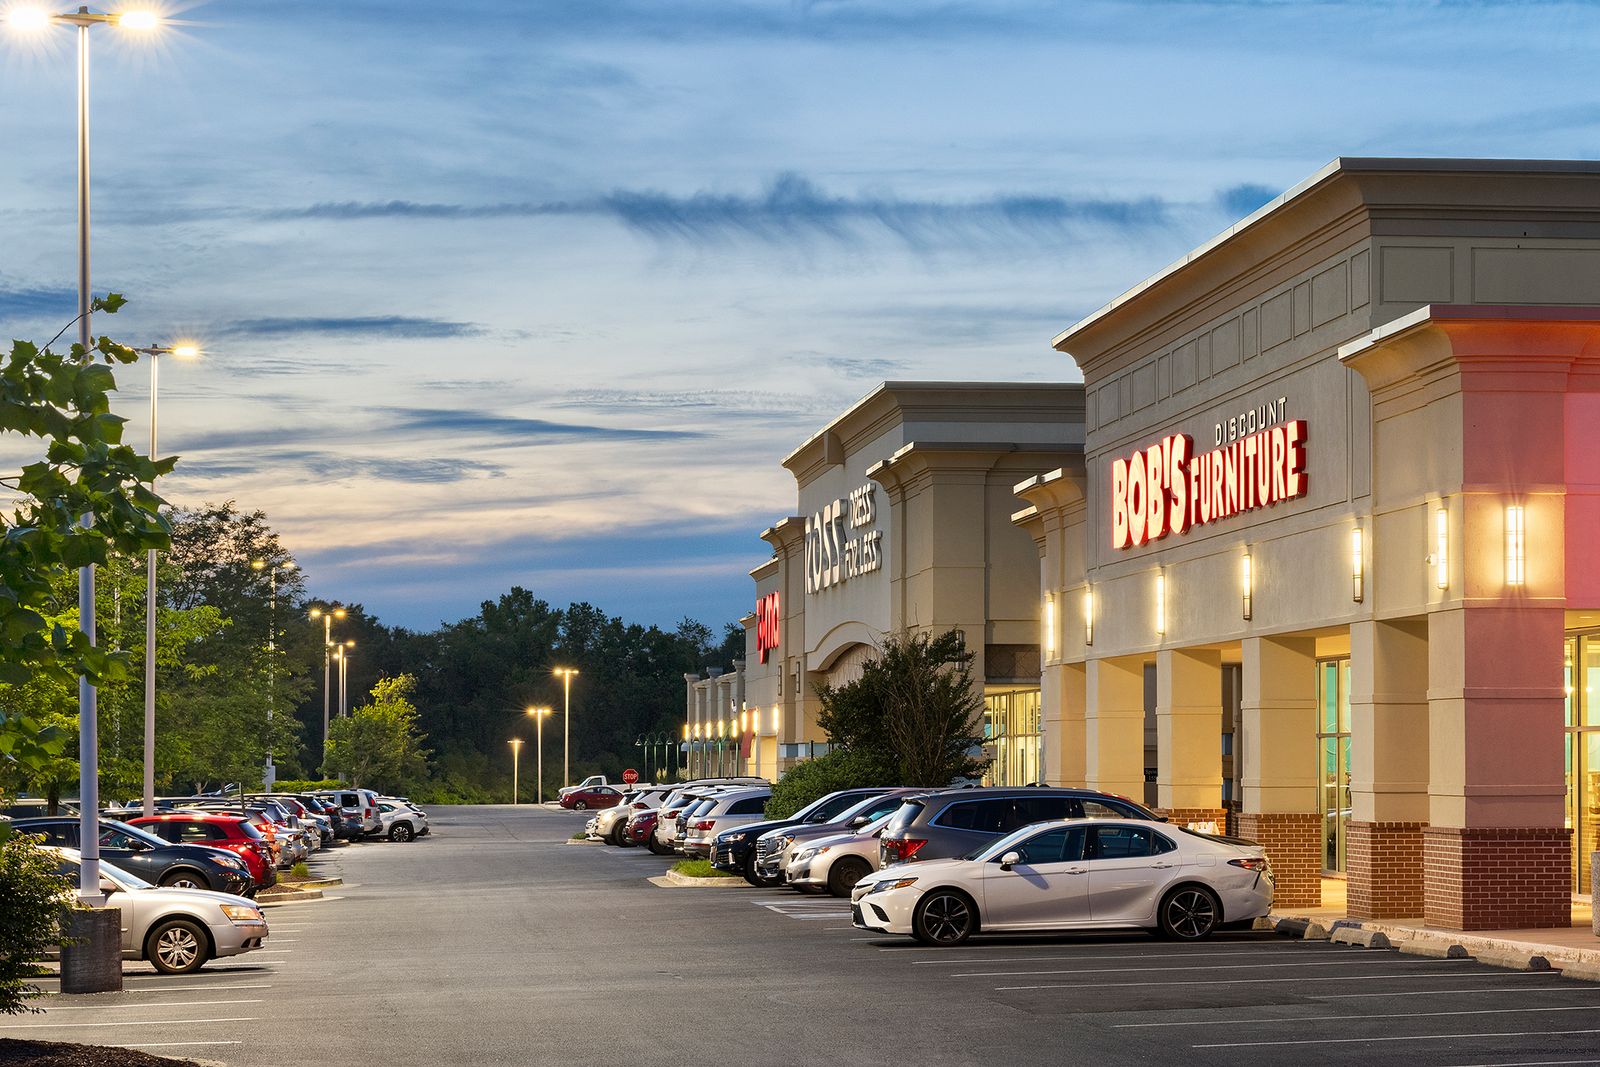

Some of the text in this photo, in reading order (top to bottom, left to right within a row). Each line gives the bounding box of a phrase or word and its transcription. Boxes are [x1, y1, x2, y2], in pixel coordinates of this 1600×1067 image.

[1215, 397, 1287, 446] DISCOUNT
[849, 482, 876, 529] DRESS
[1113, 420, 1307, 549] BOB'S FURNITURE
[859, 530, 882, 575] LESS
